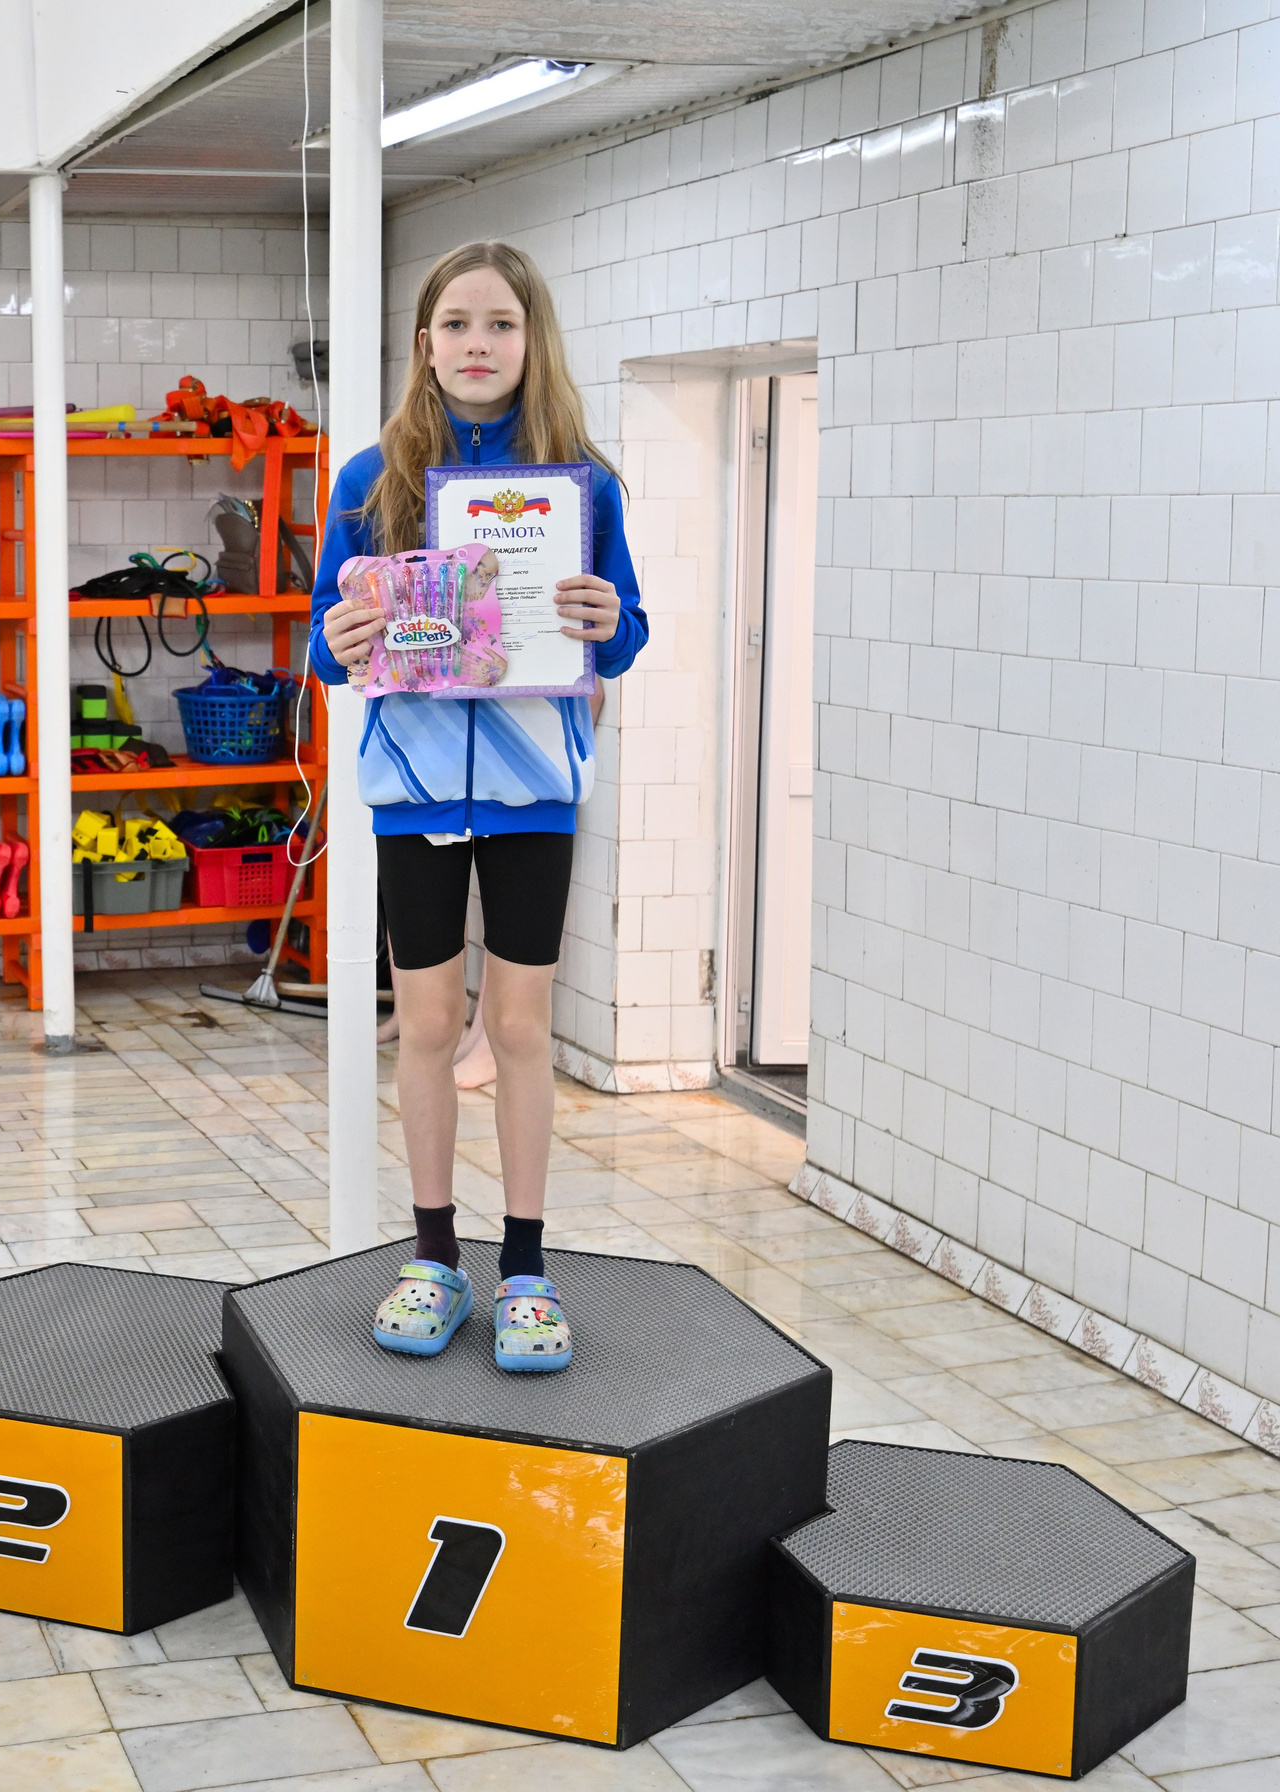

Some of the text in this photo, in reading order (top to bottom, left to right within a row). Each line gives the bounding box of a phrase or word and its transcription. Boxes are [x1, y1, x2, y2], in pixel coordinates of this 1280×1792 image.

[474, 527, 545, 539] ГРАМОТА
[397, 619, 447, 633] Tattoo
[393, 630, 453, 644] GelPens
[404, 1515, 506, 1638] 1
[884, 1647, 1019, 1731] 3
